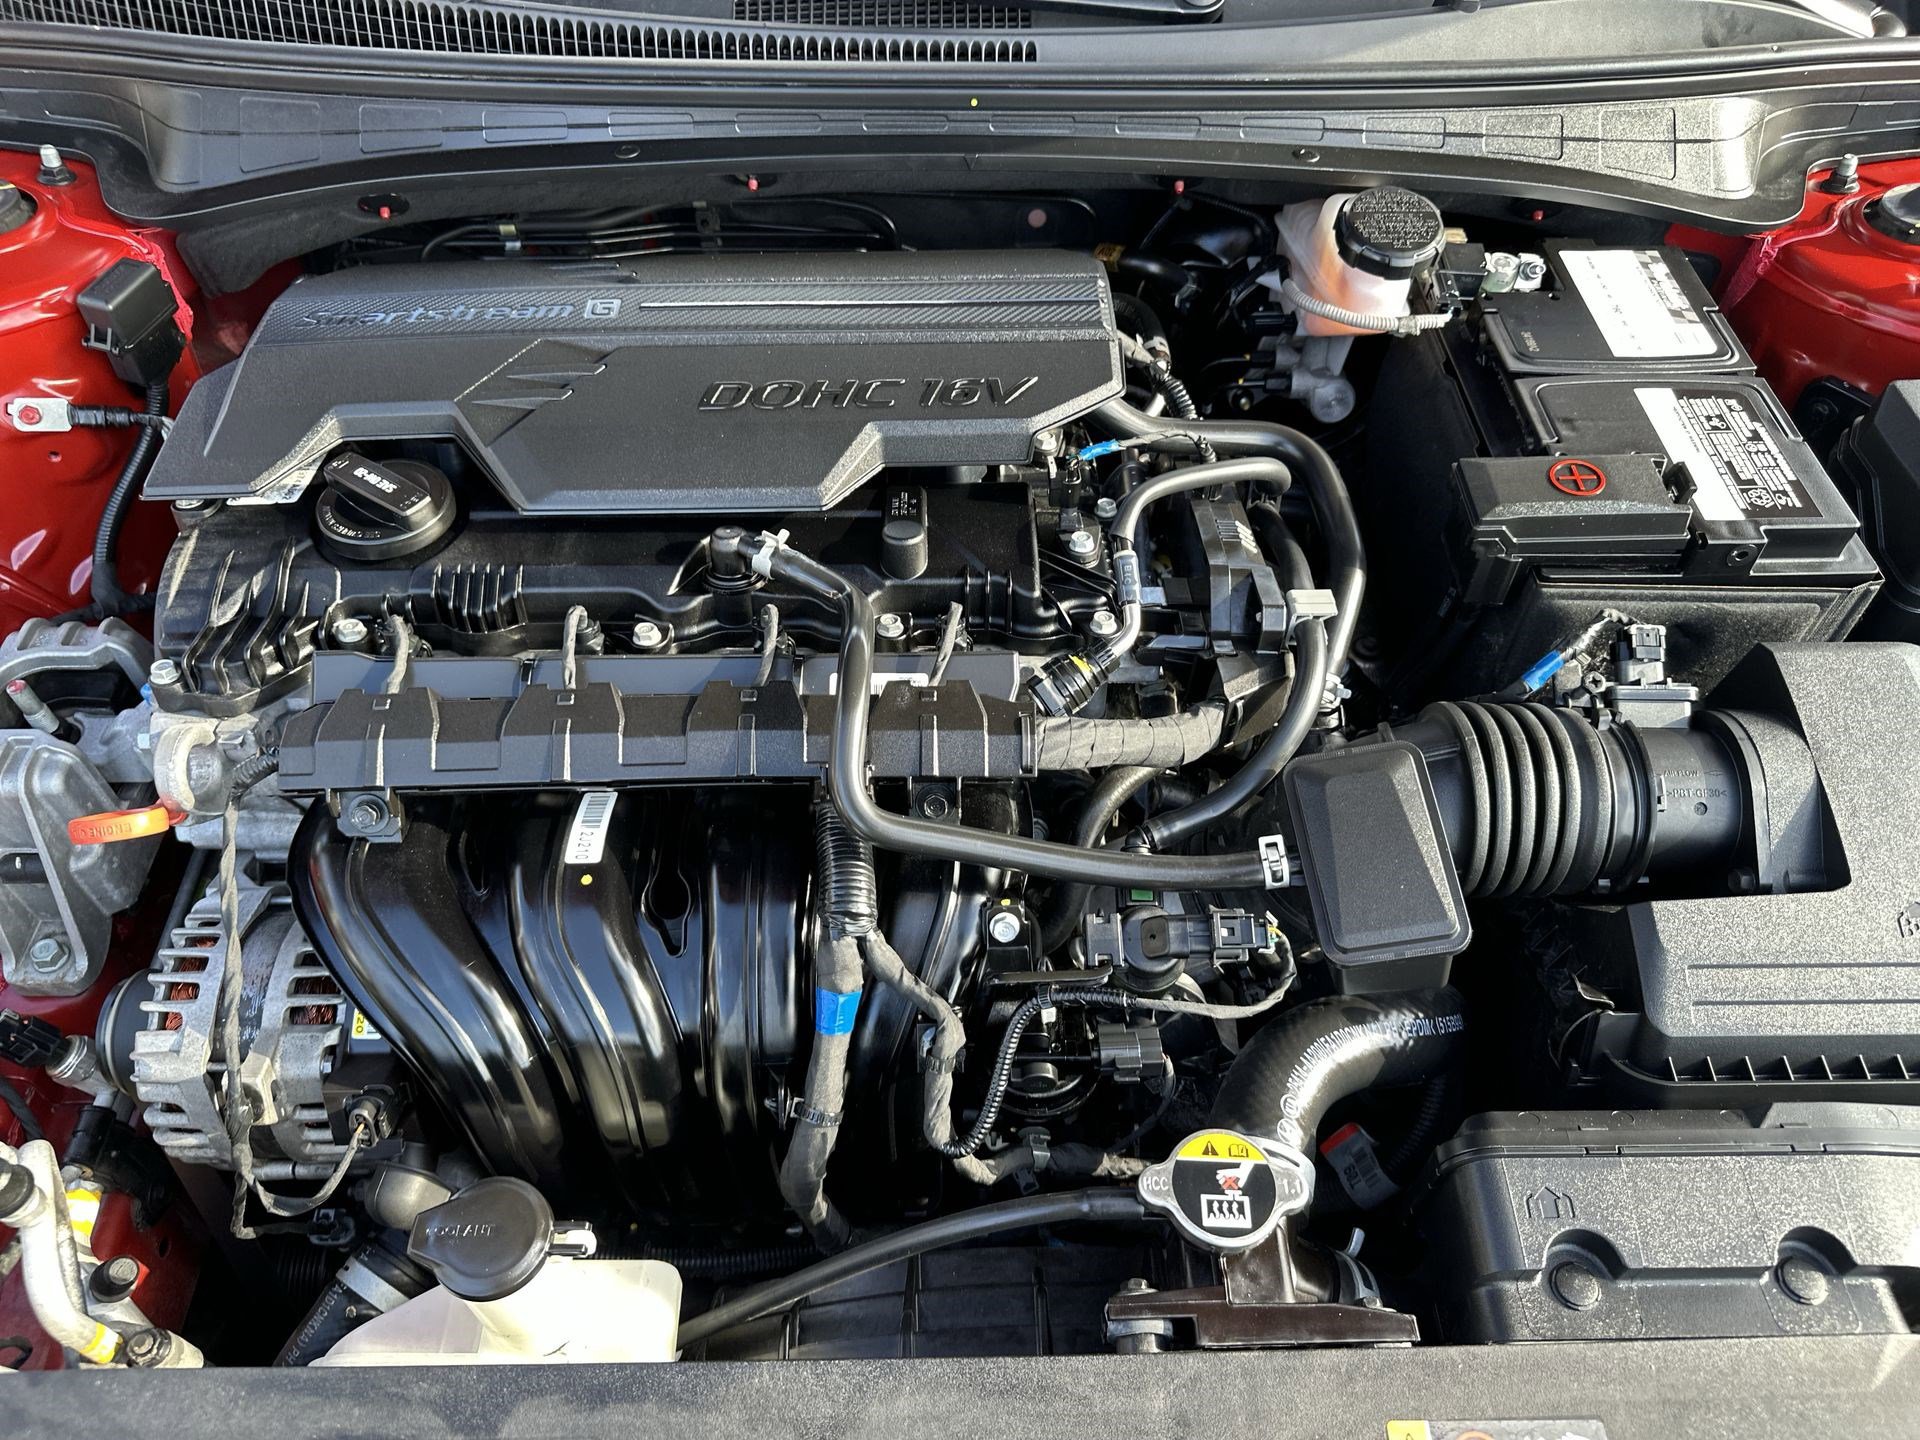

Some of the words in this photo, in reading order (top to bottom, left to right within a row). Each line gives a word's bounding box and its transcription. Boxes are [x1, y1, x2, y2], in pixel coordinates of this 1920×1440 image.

[299, 303, 574, 327] Smartstream
[699, 378, 906, 410] DOHC
[918, 376, 1039, 408] 16V
[90, 823, 132, 838] ENGINE
[1142, 1176, 1169, 1191] HCC
[1281, 1179, 1302, 1195] 1.1
[426, 1224, 496, 1237] COOLANT
